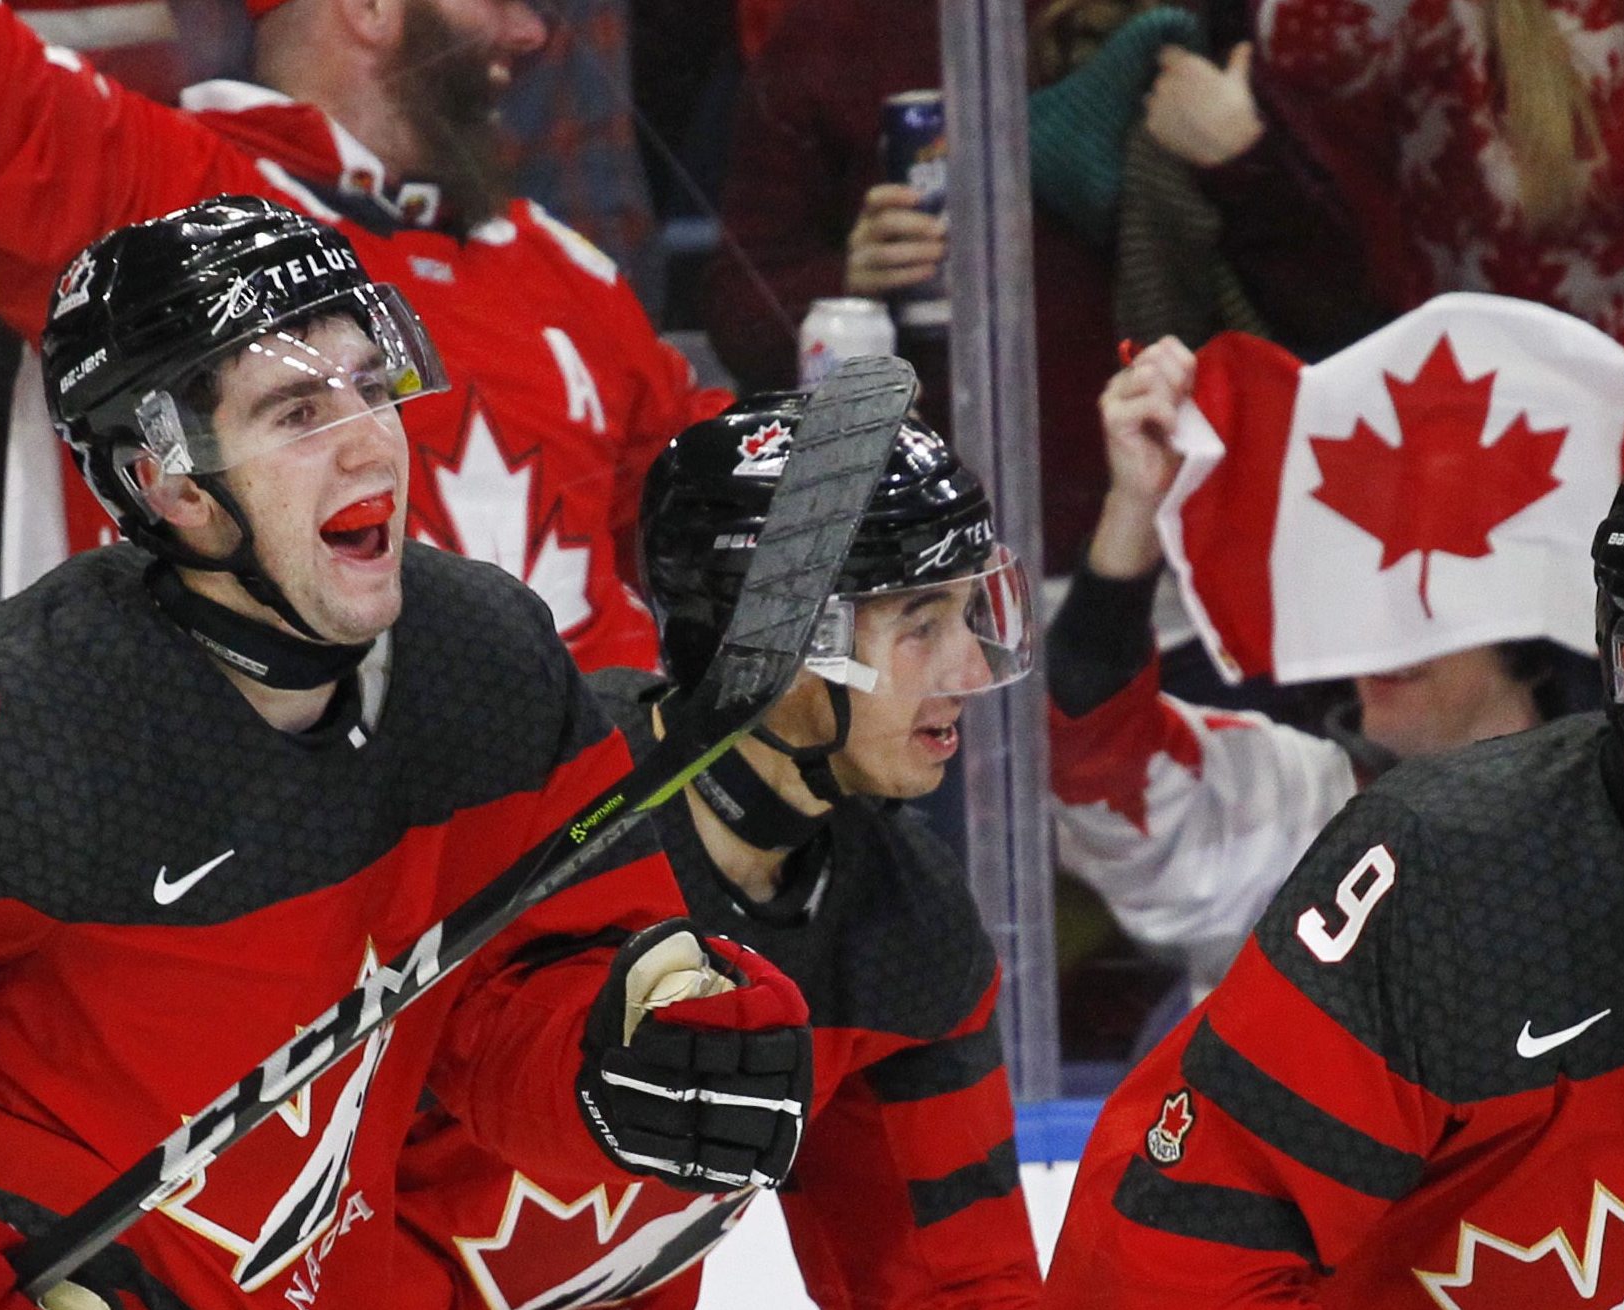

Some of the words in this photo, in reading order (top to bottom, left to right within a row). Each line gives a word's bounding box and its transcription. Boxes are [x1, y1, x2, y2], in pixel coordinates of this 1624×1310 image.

[264, 248, 356, 290] TELUS
[542, 326, 605, 433] A
[1296, 844, 1396, 962] 9
[159, 920, 445, 1181] CCM
